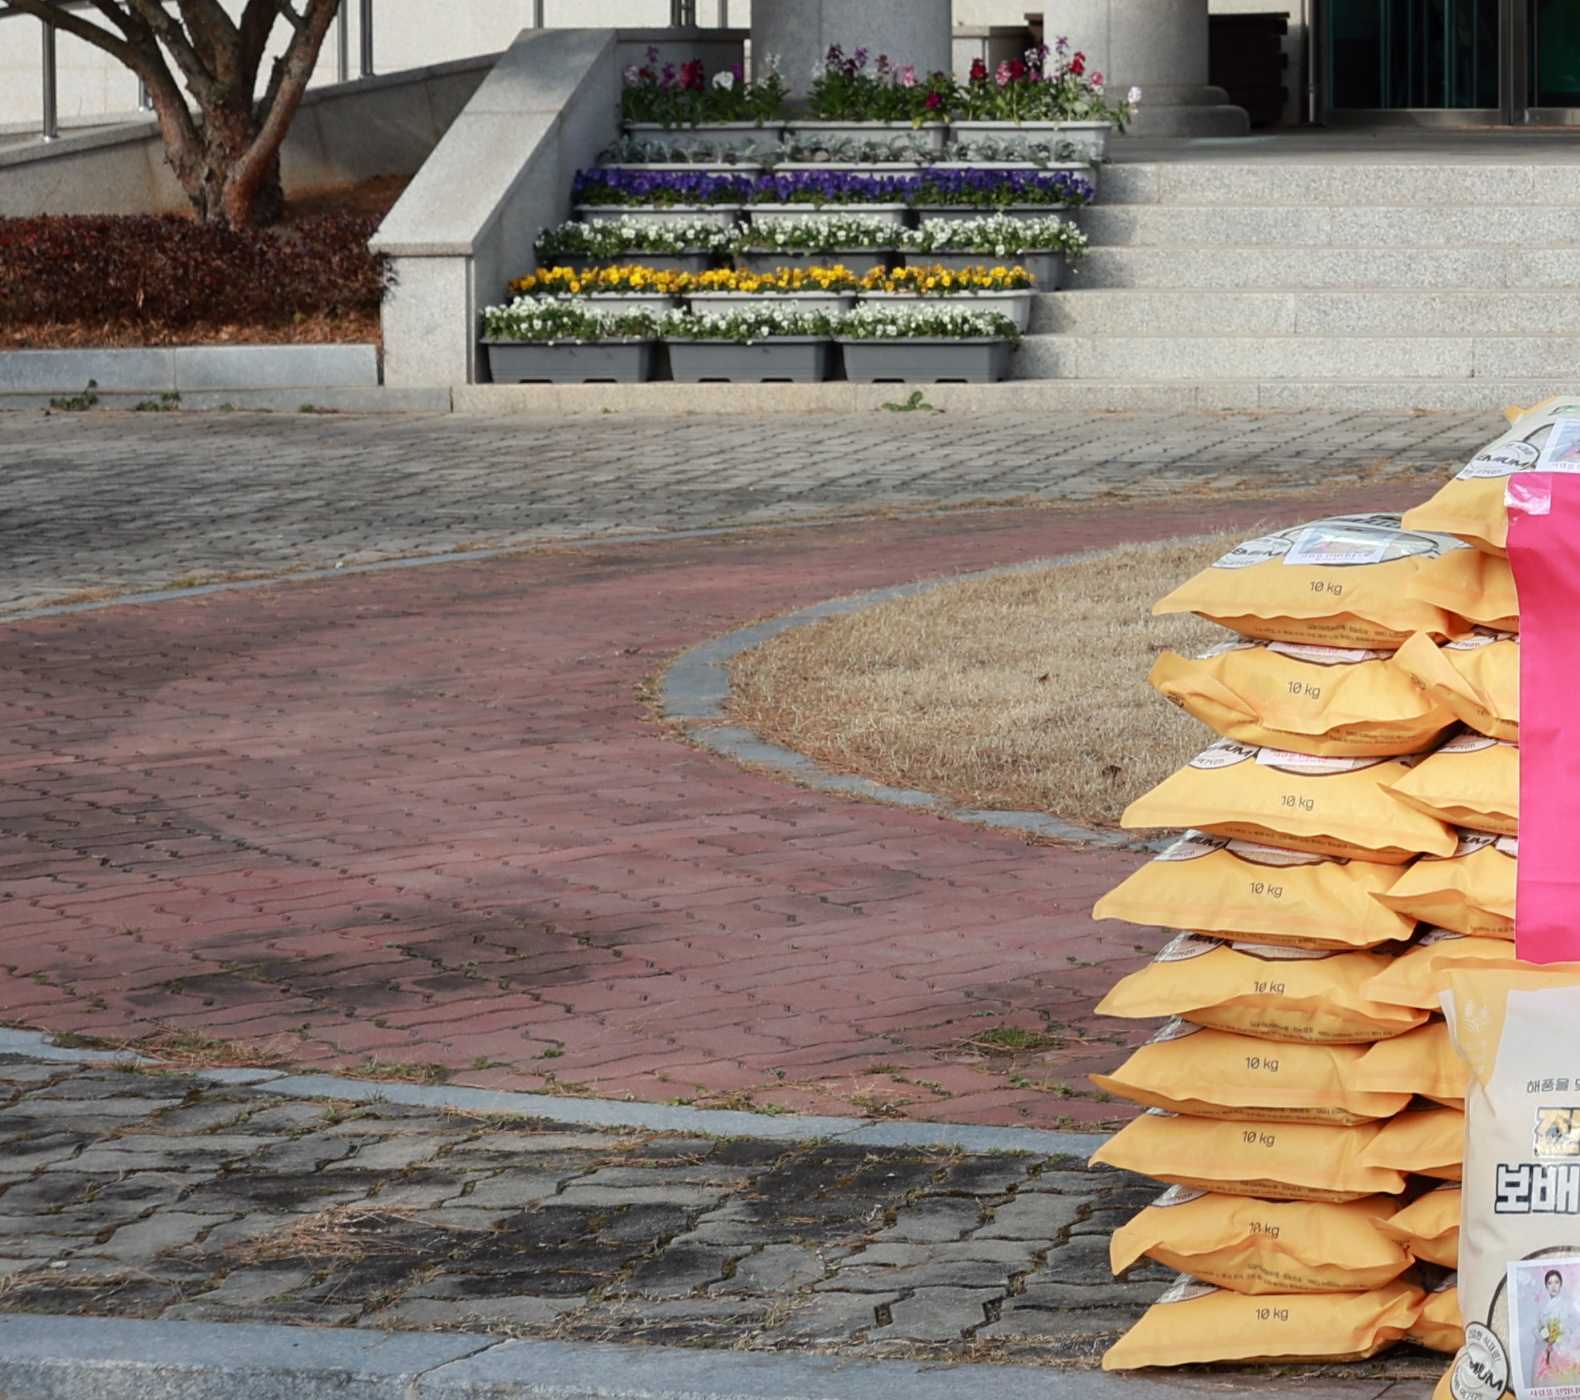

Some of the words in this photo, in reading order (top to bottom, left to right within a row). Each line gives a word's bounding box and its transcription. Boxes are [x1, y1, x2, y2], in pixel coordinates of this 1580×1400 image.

[1310, 581, 1324, 593] 10
[1326, 582, 1343, 595] kg
[1288, 681, 1301, 693] 10
[1305, 683, 1320, 698] kg
[1281, 795, 1295, 807] 10
[1298, 796, 1314, 811] kg
[1250, 883, 1264, 894] 10
[1267, 883, 1283, 898] kg
[1254, 982, 1267, 993] 10
[1270, 982, 1285, 994] kg
[1245, 1058, 1260, 1069] 10
[1263, 1058, 1279, 1072] kg
[1526, 1078, 1569, 1094] 해풍을
[1243, 1131, 1256, 1143] 10
[1259, 1133, 1275, 1147] kg
[1265, 1224, 1279, 1238] kg
[1255, 1309, 1269, 1320] 10
[1273, 1308, 1288, 1321] kg
